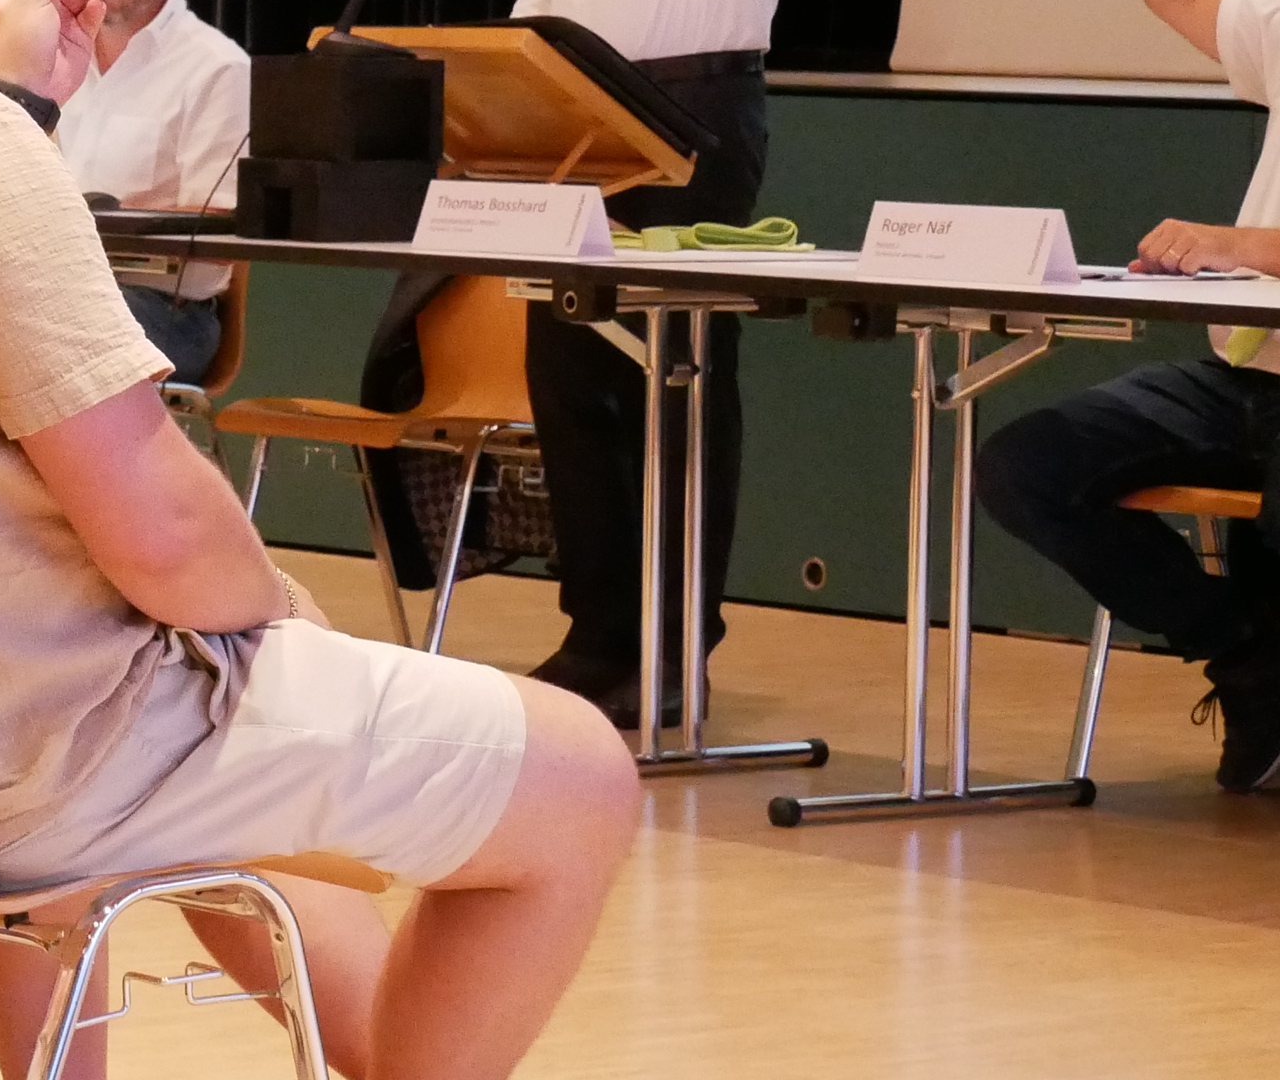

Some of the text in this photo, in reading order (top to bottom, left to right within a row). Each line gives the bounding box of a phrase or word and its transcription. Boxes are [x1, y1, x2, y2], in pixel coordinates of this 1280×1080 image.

[438, 196, 548, 213] Thomas Bosshard
[881, 218, 953, 236] Roger Näf
